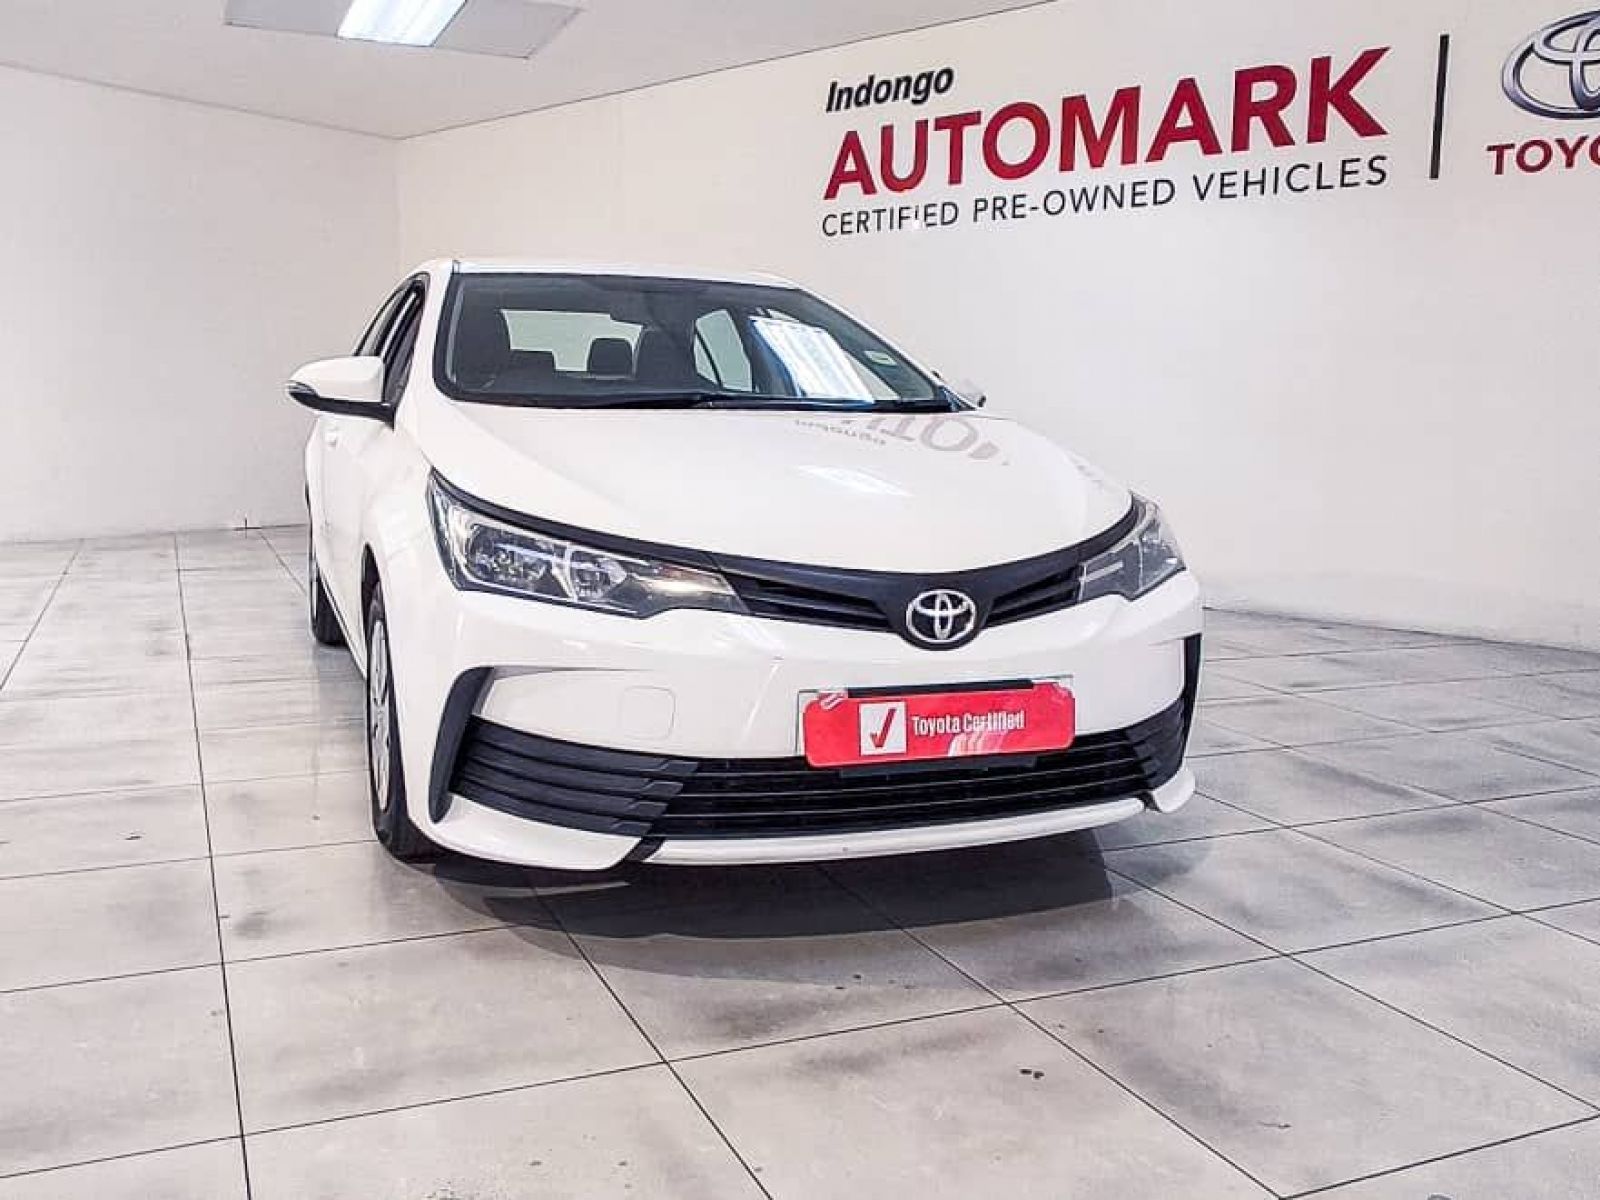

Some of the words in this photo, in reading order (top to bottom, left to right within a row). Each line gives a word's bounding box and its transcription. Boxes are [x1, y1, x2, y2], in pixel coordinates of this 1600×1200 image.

[825, 67, 955, 113] Indongo
[823, 46, 1391, 200] AUTOMARK
[822, 201, 959, 237] CERTIFIED
[972, 178, 1176, 223] PRE-OWNED
[1193, 155, 1389, 201] VEHICLES
[911, 714, 960, 737] Toyota
